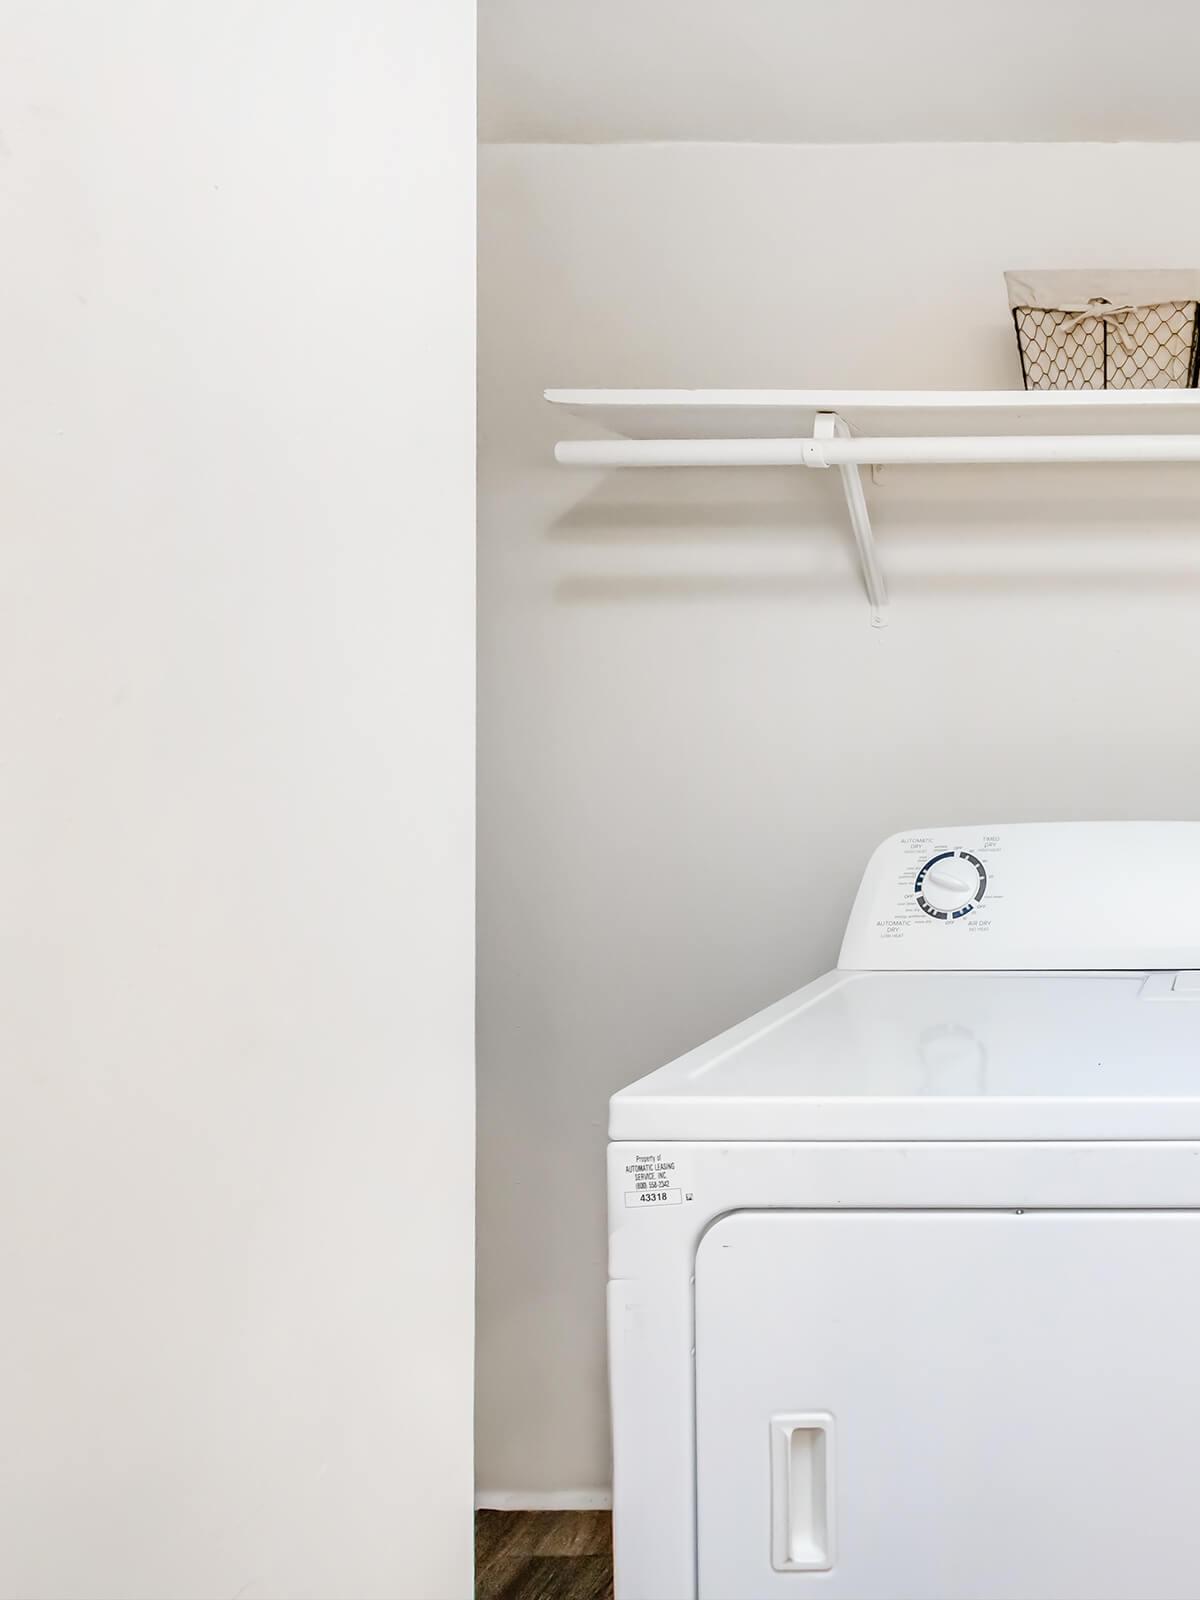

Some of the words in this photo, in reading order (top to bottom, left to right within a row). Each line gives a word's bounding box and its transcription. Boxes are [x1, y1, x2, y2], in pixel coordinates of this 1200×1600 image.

[635, 1155, 655, 1163] Property
[625, 1164, 654, 1174] AUTOMATIC
[654, 1162, 675, 1171] LEASING
[640, 1192, 668, 1202] 43318
